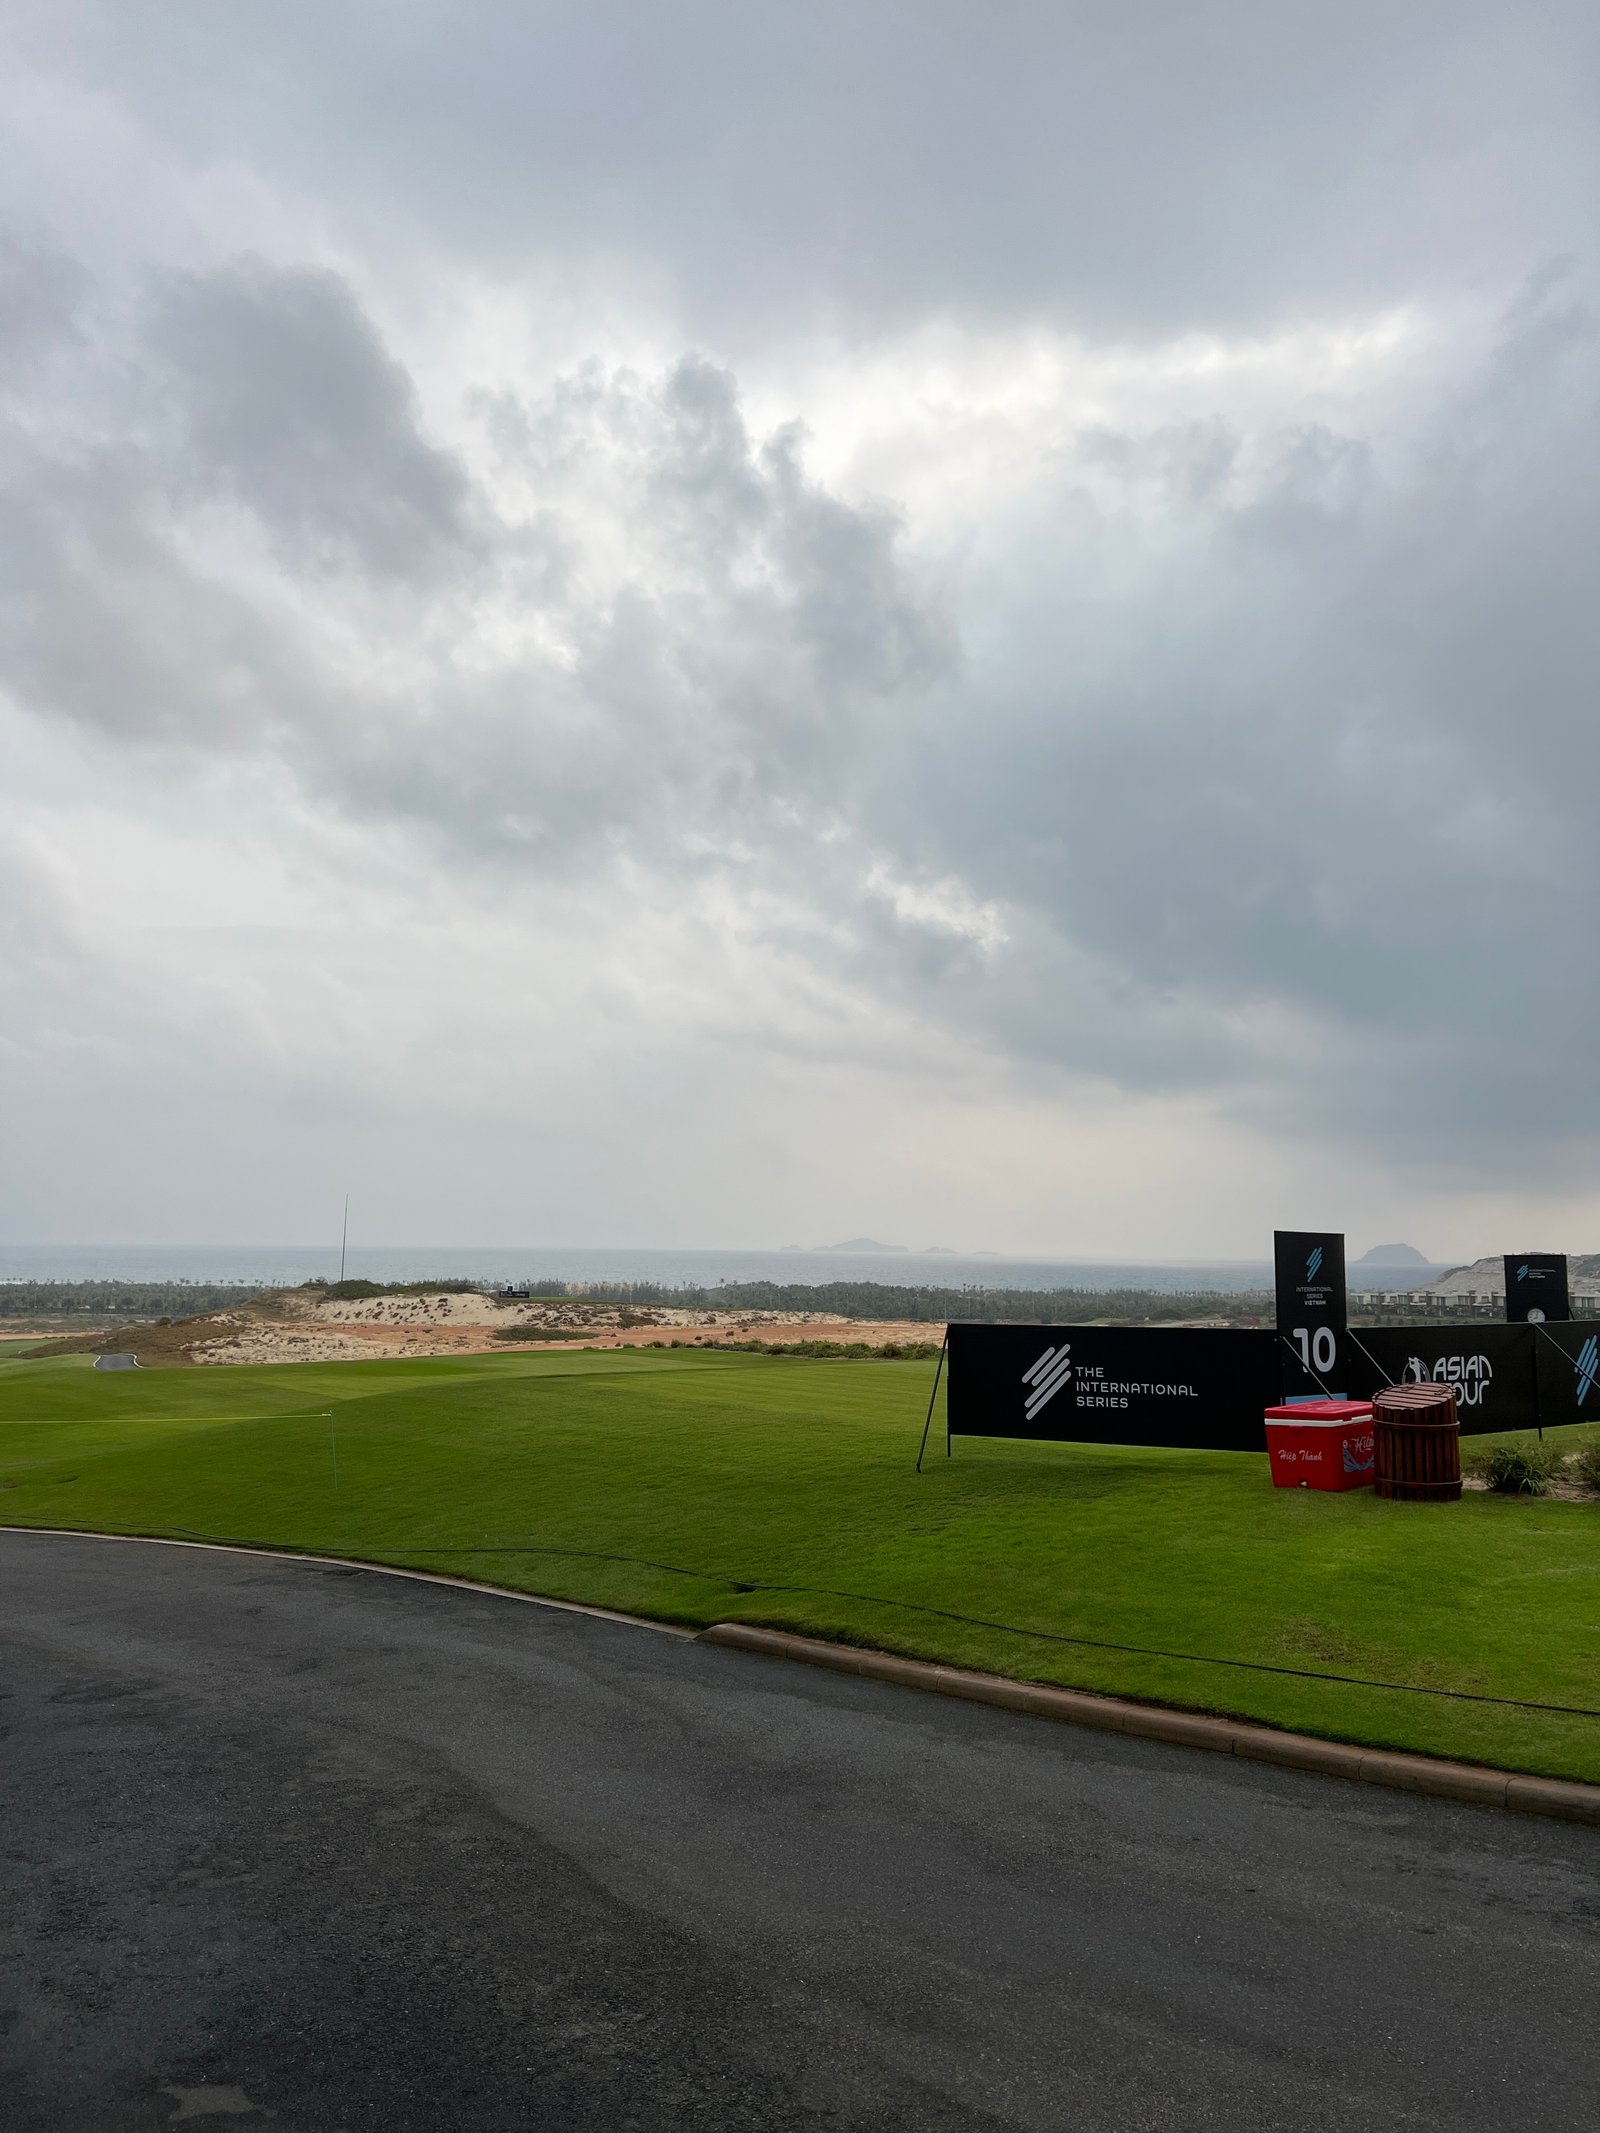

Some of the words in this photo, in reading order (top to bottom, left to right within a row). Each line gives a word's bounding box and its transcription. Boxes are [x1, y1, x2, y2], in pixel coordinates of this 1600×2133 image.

[1293, 1326, 1336, 1373] 10
[1075, 1366, 1104, 1378] THE
[1432, 1355, 1493, 1381] ASIAN
[1076, 1381, 1199, 1397] INTERNATIONAL
[1448, 1380, 1490, 1407] OUR
[1076, 1396, 1129, 1409] SERIES
